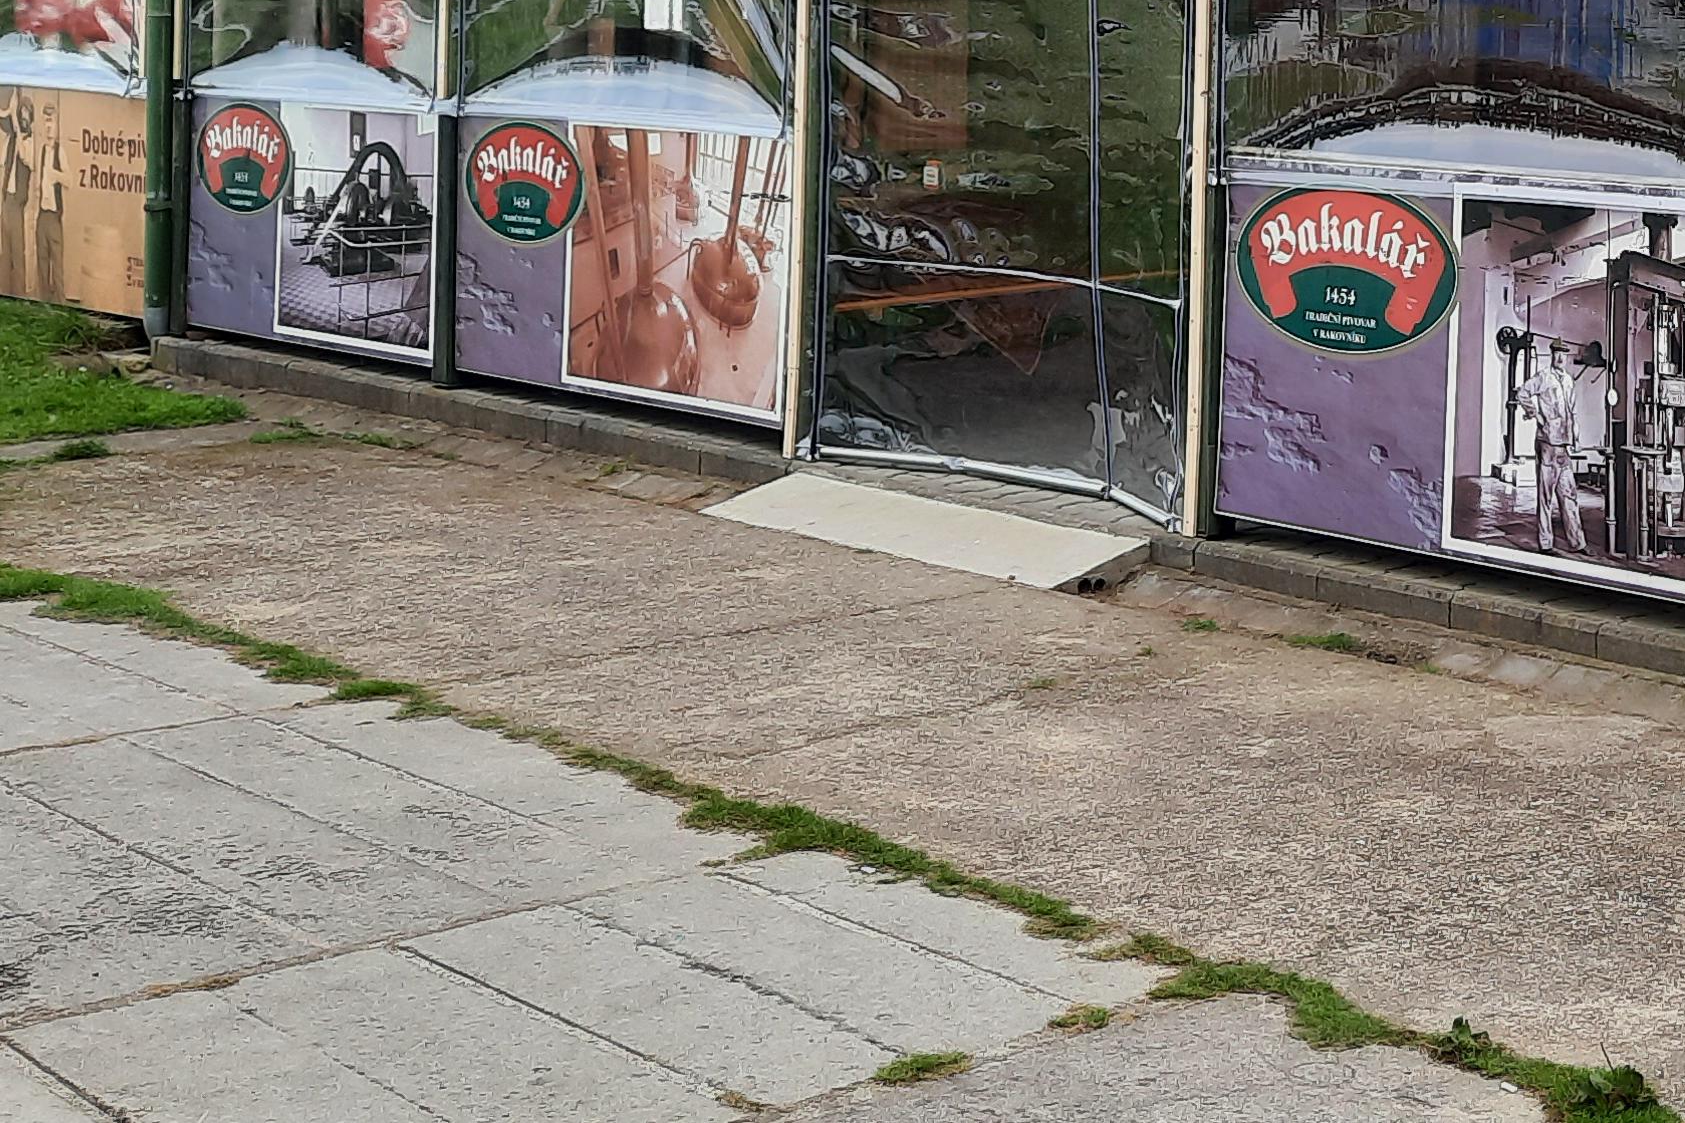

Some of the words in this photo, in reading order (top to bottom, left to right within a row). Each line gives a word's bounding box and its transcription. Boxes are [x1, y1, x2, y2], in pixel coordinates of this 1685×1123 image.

[82, 128, 124, 157] Dobré
[476, 135, 569, 189] Bakalář
[79, 168, 86, 188] z
[1260, 202, 1431, 278] Bakalář
[1325, 286, 1356, 305] 1454
